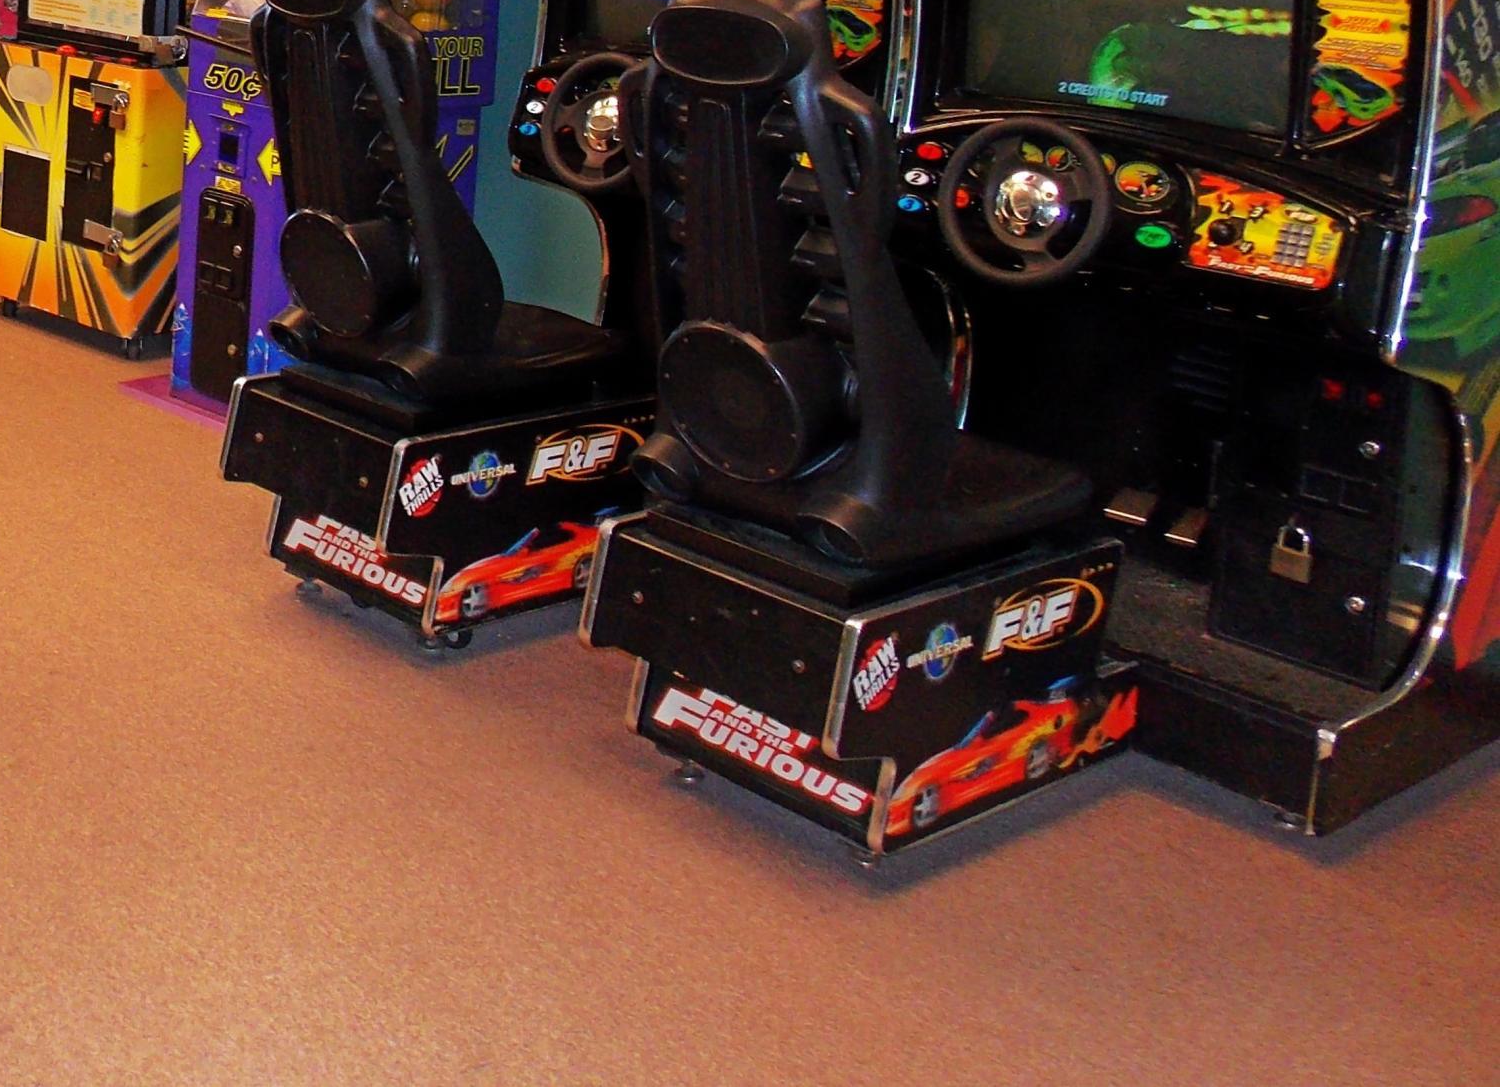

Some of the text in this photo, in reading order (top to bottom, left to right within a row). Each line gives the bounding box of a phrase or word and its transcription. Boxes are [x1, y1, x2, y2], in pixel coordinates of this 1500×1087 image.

[433, 36, 484, 58] YOUR
[204, 63, 263, 101] 50¢
[1058, 81, 1068, 93] 2
[1130, 90, 1169, 106] START
[530, 103, 539, 112] 2
[911, 172, 922, 183] 2
[1250, 206, 1265, 218] 3
[451, 463, 516, 486] UNIVERSAL
[528, 432, 618, 482] F&F
[399, 457, 440, 506] RAW
[404, 475, 444, 516] THRILLS
[315, 514, 388, 557] FAS
[322, 533, 379, 562] AND THE
[283, 518, 428, 604] FURIOUS
[984, 589, 1077, 656] F&F
[853, 636, 896, 699] RAW
[906, 635, 974, 669] UNIVERSAL
[858, 656, 900, 711] THRILLS
[653, 688, 869, 812] FURIOUS
[709, 708, 795, 753] AND THE
